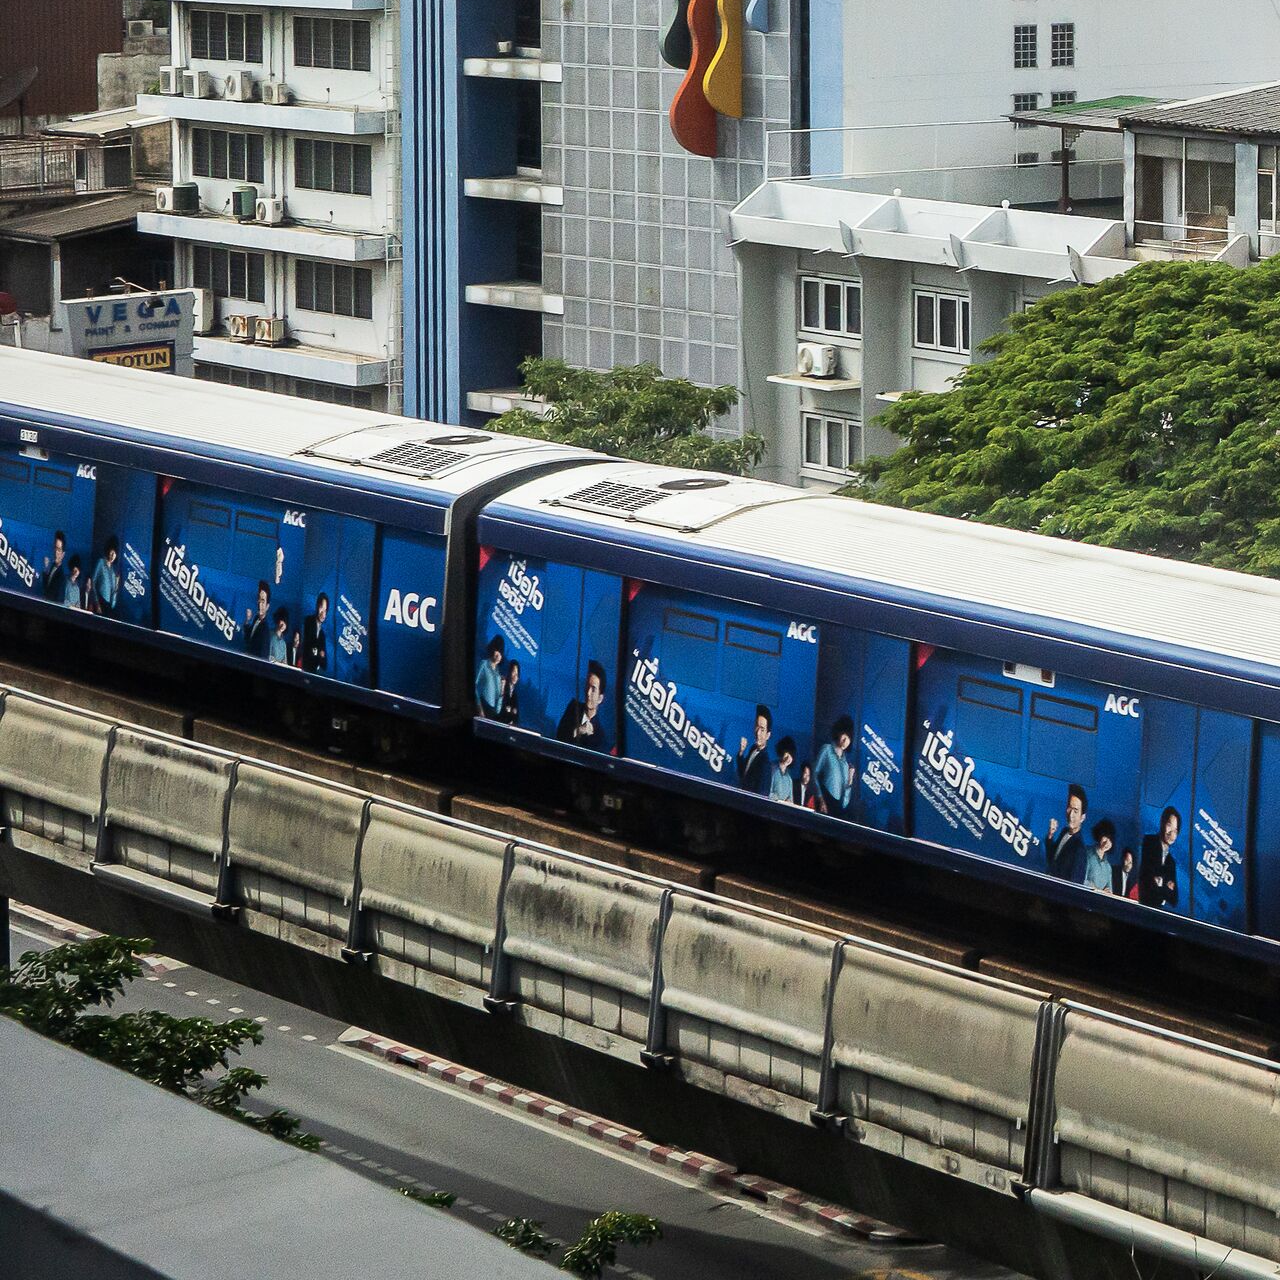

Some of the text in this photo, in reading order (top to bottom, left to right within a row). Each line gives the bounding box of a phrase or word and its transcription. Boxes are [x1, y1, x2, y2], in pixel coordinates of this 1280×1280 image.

[115, 351, 167, 368] JOTUN
[76, 463, 97, 480] AGC
[283, 509, 306, 528] AGC
[384, 588, 437, 633] AGC
[786, 621, 817, 644] AGC
[1104, 693, 1140, 718] AGC
